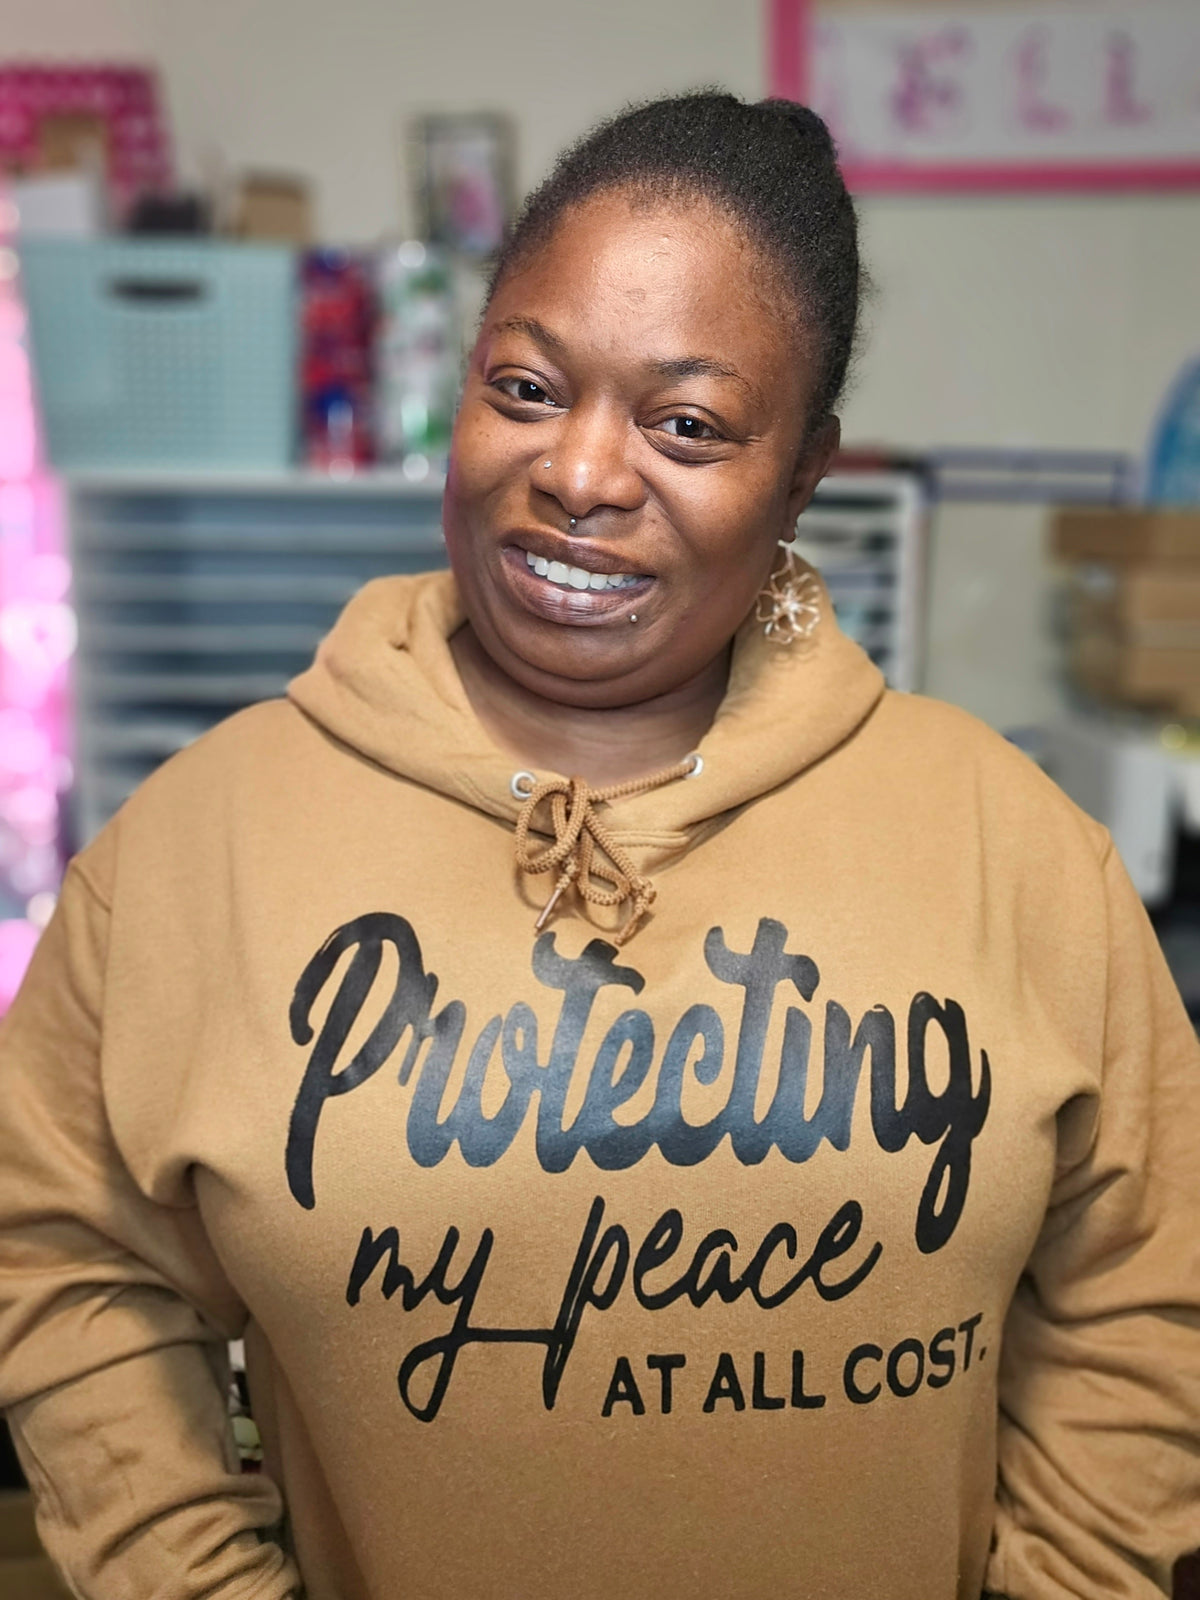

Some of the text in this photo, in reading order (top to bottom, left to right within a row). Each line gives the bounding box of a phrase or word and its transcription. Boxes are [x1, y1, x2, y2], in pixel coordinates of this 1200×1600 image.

[284, 911, 992, 1255] Protecting
[345, 1195, 884, 1424] my peace
[601, 1311, 988, 1418] AT ALL COST.
